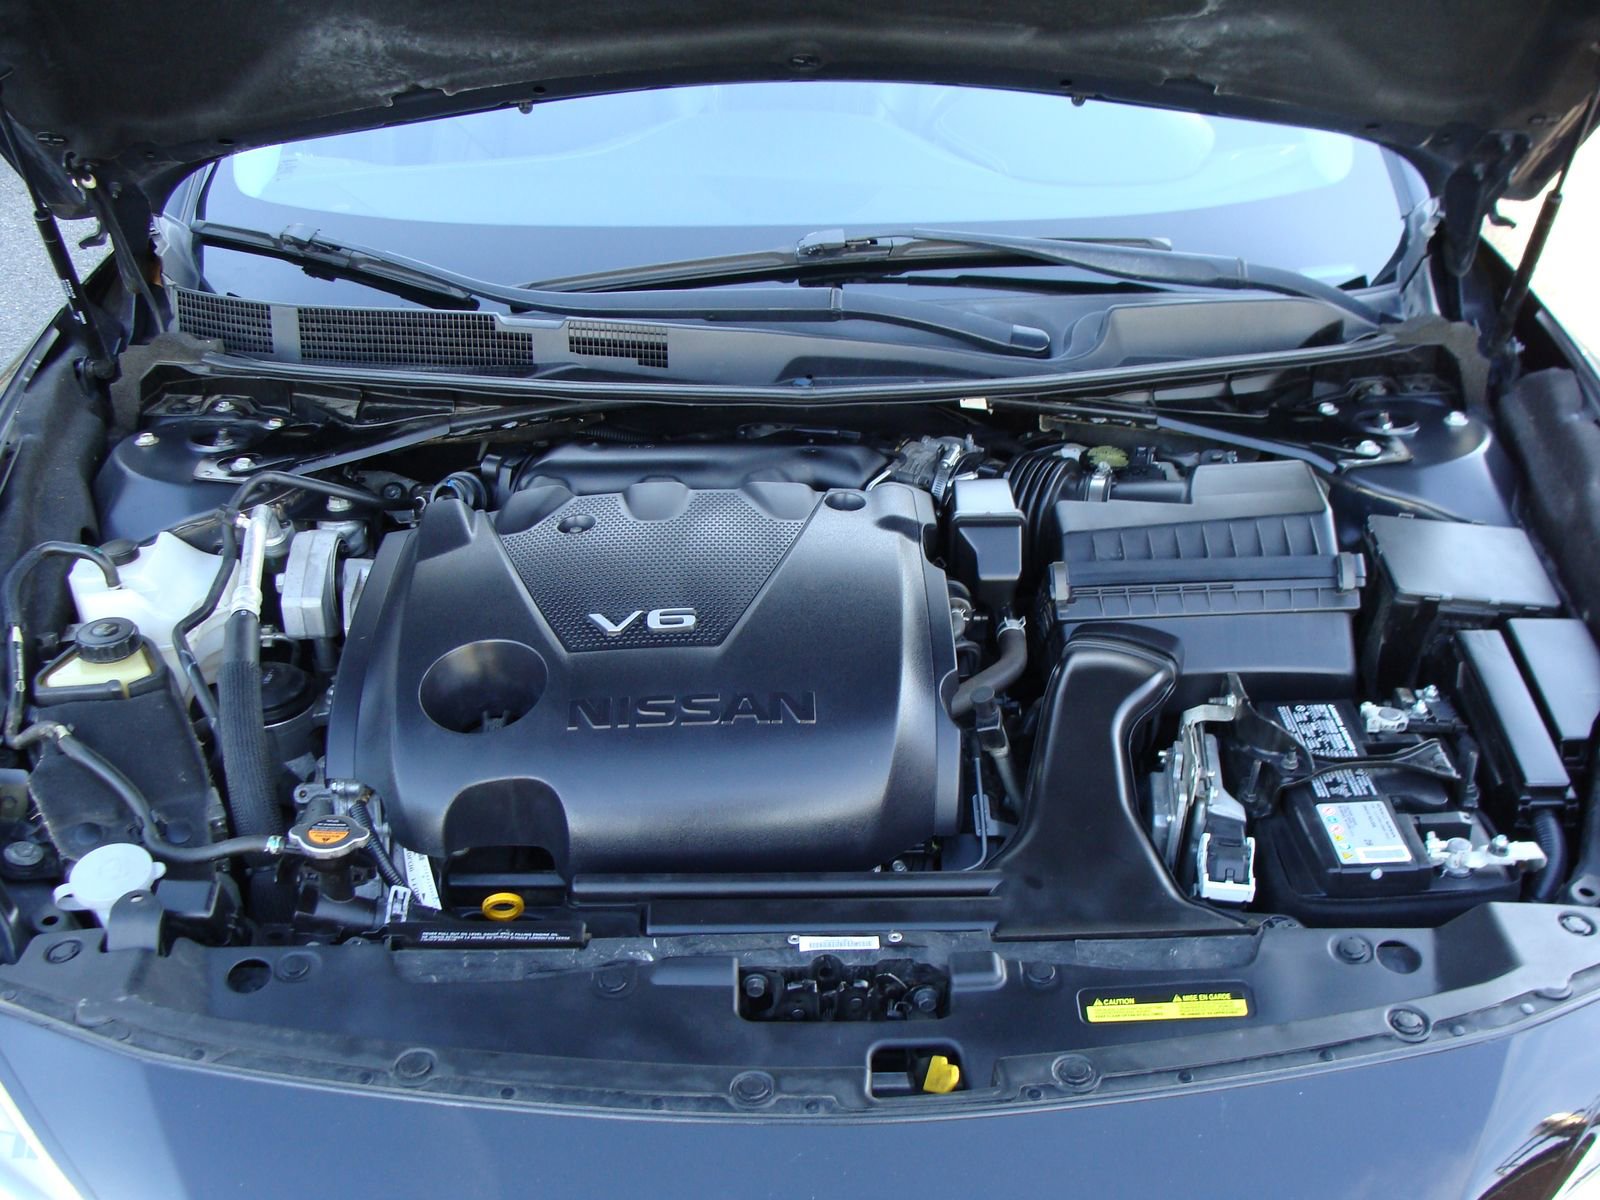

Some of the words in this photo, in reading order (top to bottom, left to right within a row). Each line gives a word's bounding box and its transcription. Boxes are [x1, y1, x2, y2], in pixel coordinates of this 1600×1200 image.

[588, 607, 697, 637] V6
[566, 691, 818, 732] NISSAN
[1103, 997, 1135, 1005] CAUTION
[1182, 993, 1198, 1001] MISE
[1209, 992, 1232, 1000] GARDE
